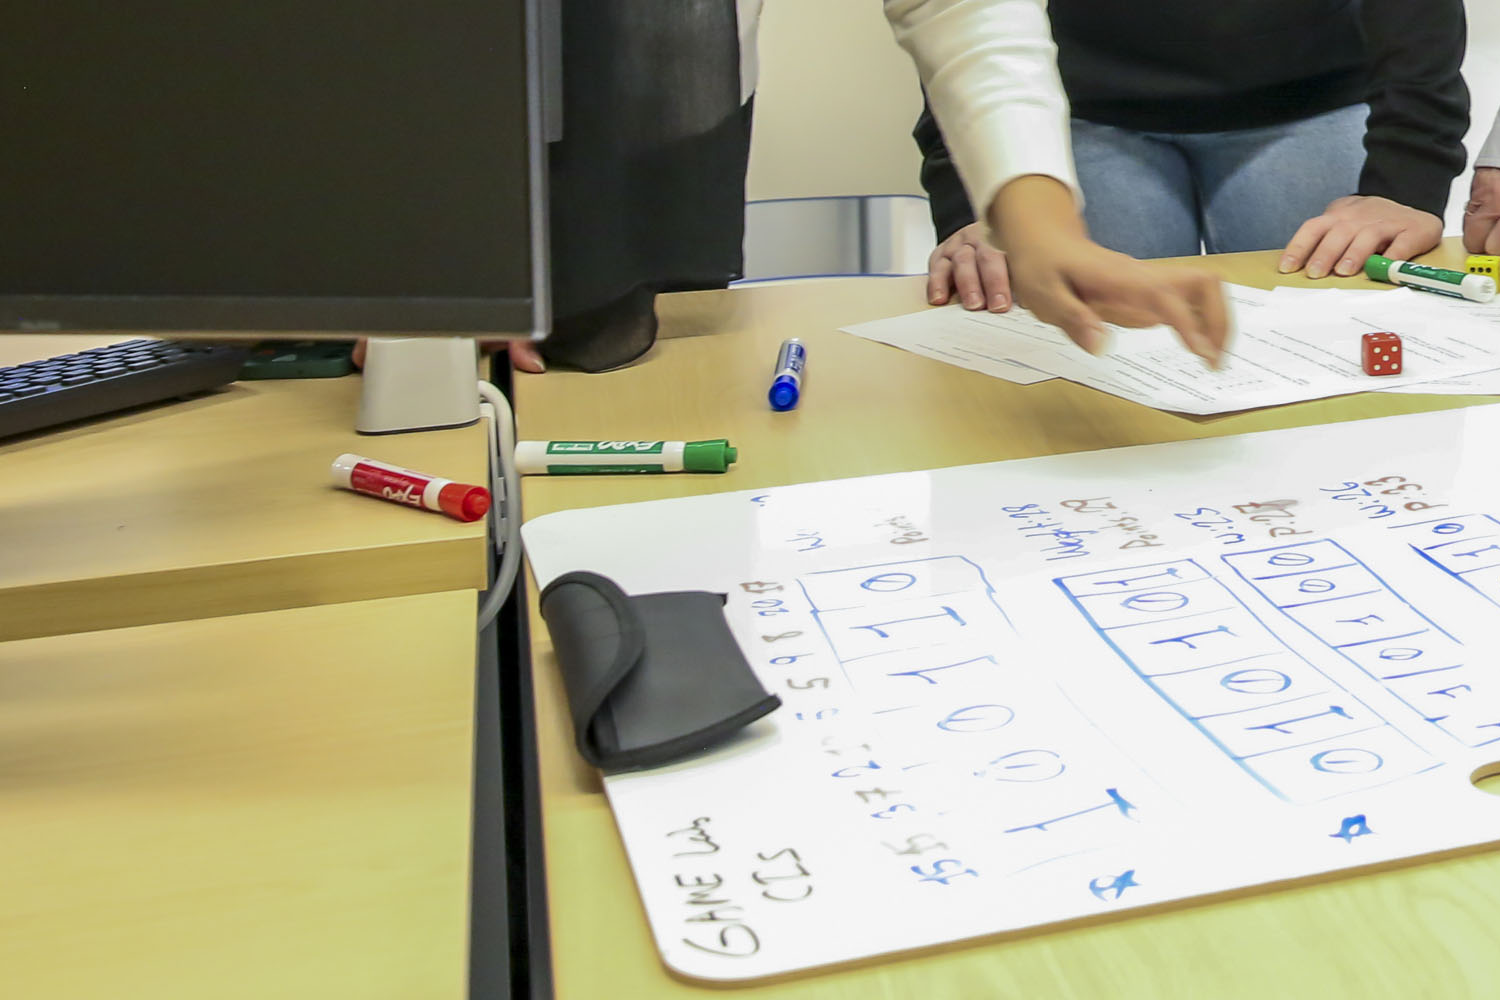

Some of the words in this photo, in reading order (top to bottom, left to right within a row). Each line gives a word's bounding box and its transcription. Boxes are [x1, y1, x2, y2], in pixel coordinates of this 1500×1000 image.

[761, 631, 803, 643] 8
[786, 677, 830, 690] 5
[854, 787, 901, 803] 7
[870, 804, 915, 819] 3
[752, 848, 813, 902] CIS
[910, 859, 978, 885] 15
[674, 873, 760, 957] GAME
